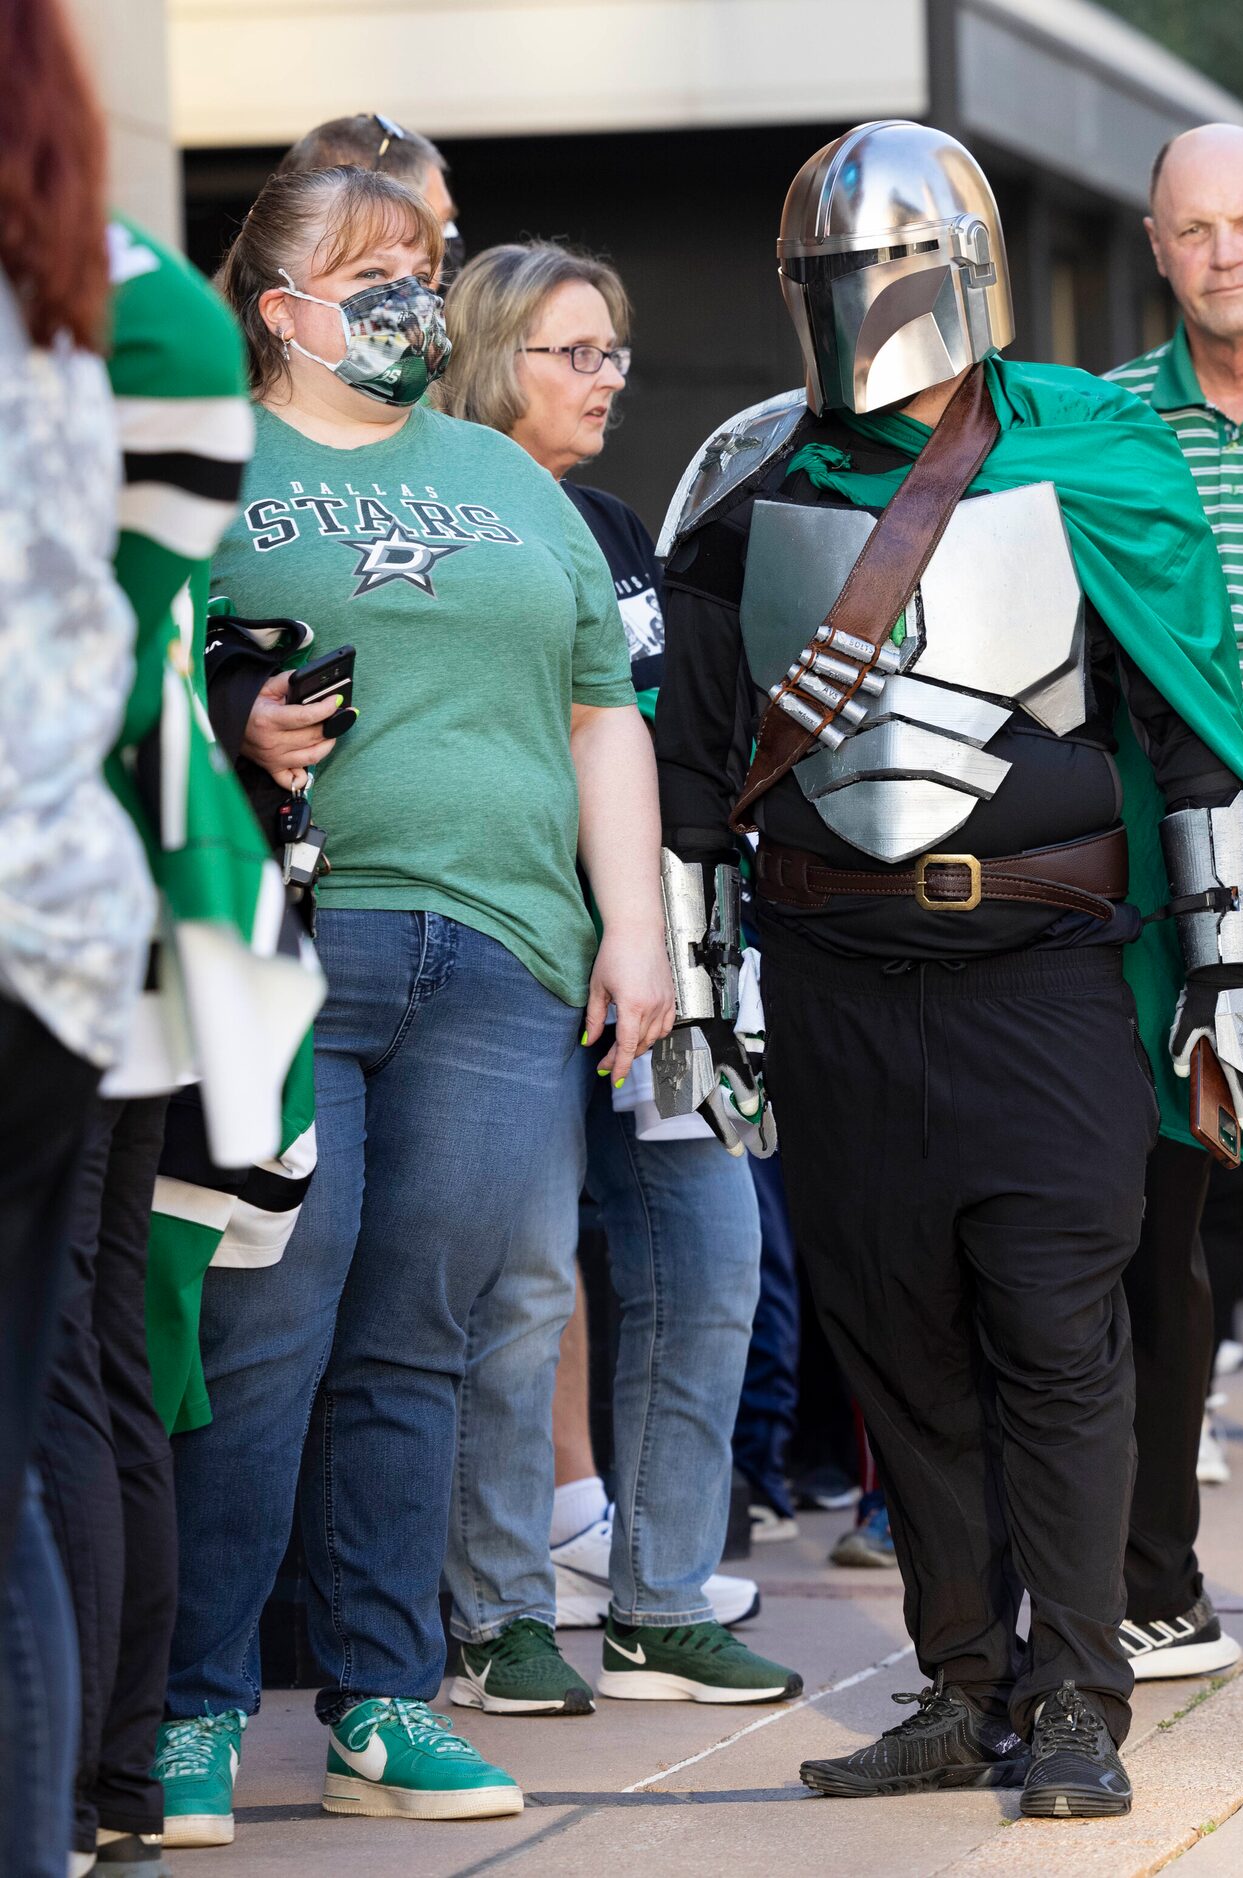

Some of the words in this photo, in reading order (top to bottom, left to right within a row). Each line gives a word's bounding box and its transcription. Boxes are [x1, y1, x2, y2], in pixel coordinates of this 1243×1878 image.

[290, 481, 439, 499] DALLAS
[244, 497, 523, 551] STARS
[823, 687, 840, 700] AVS
